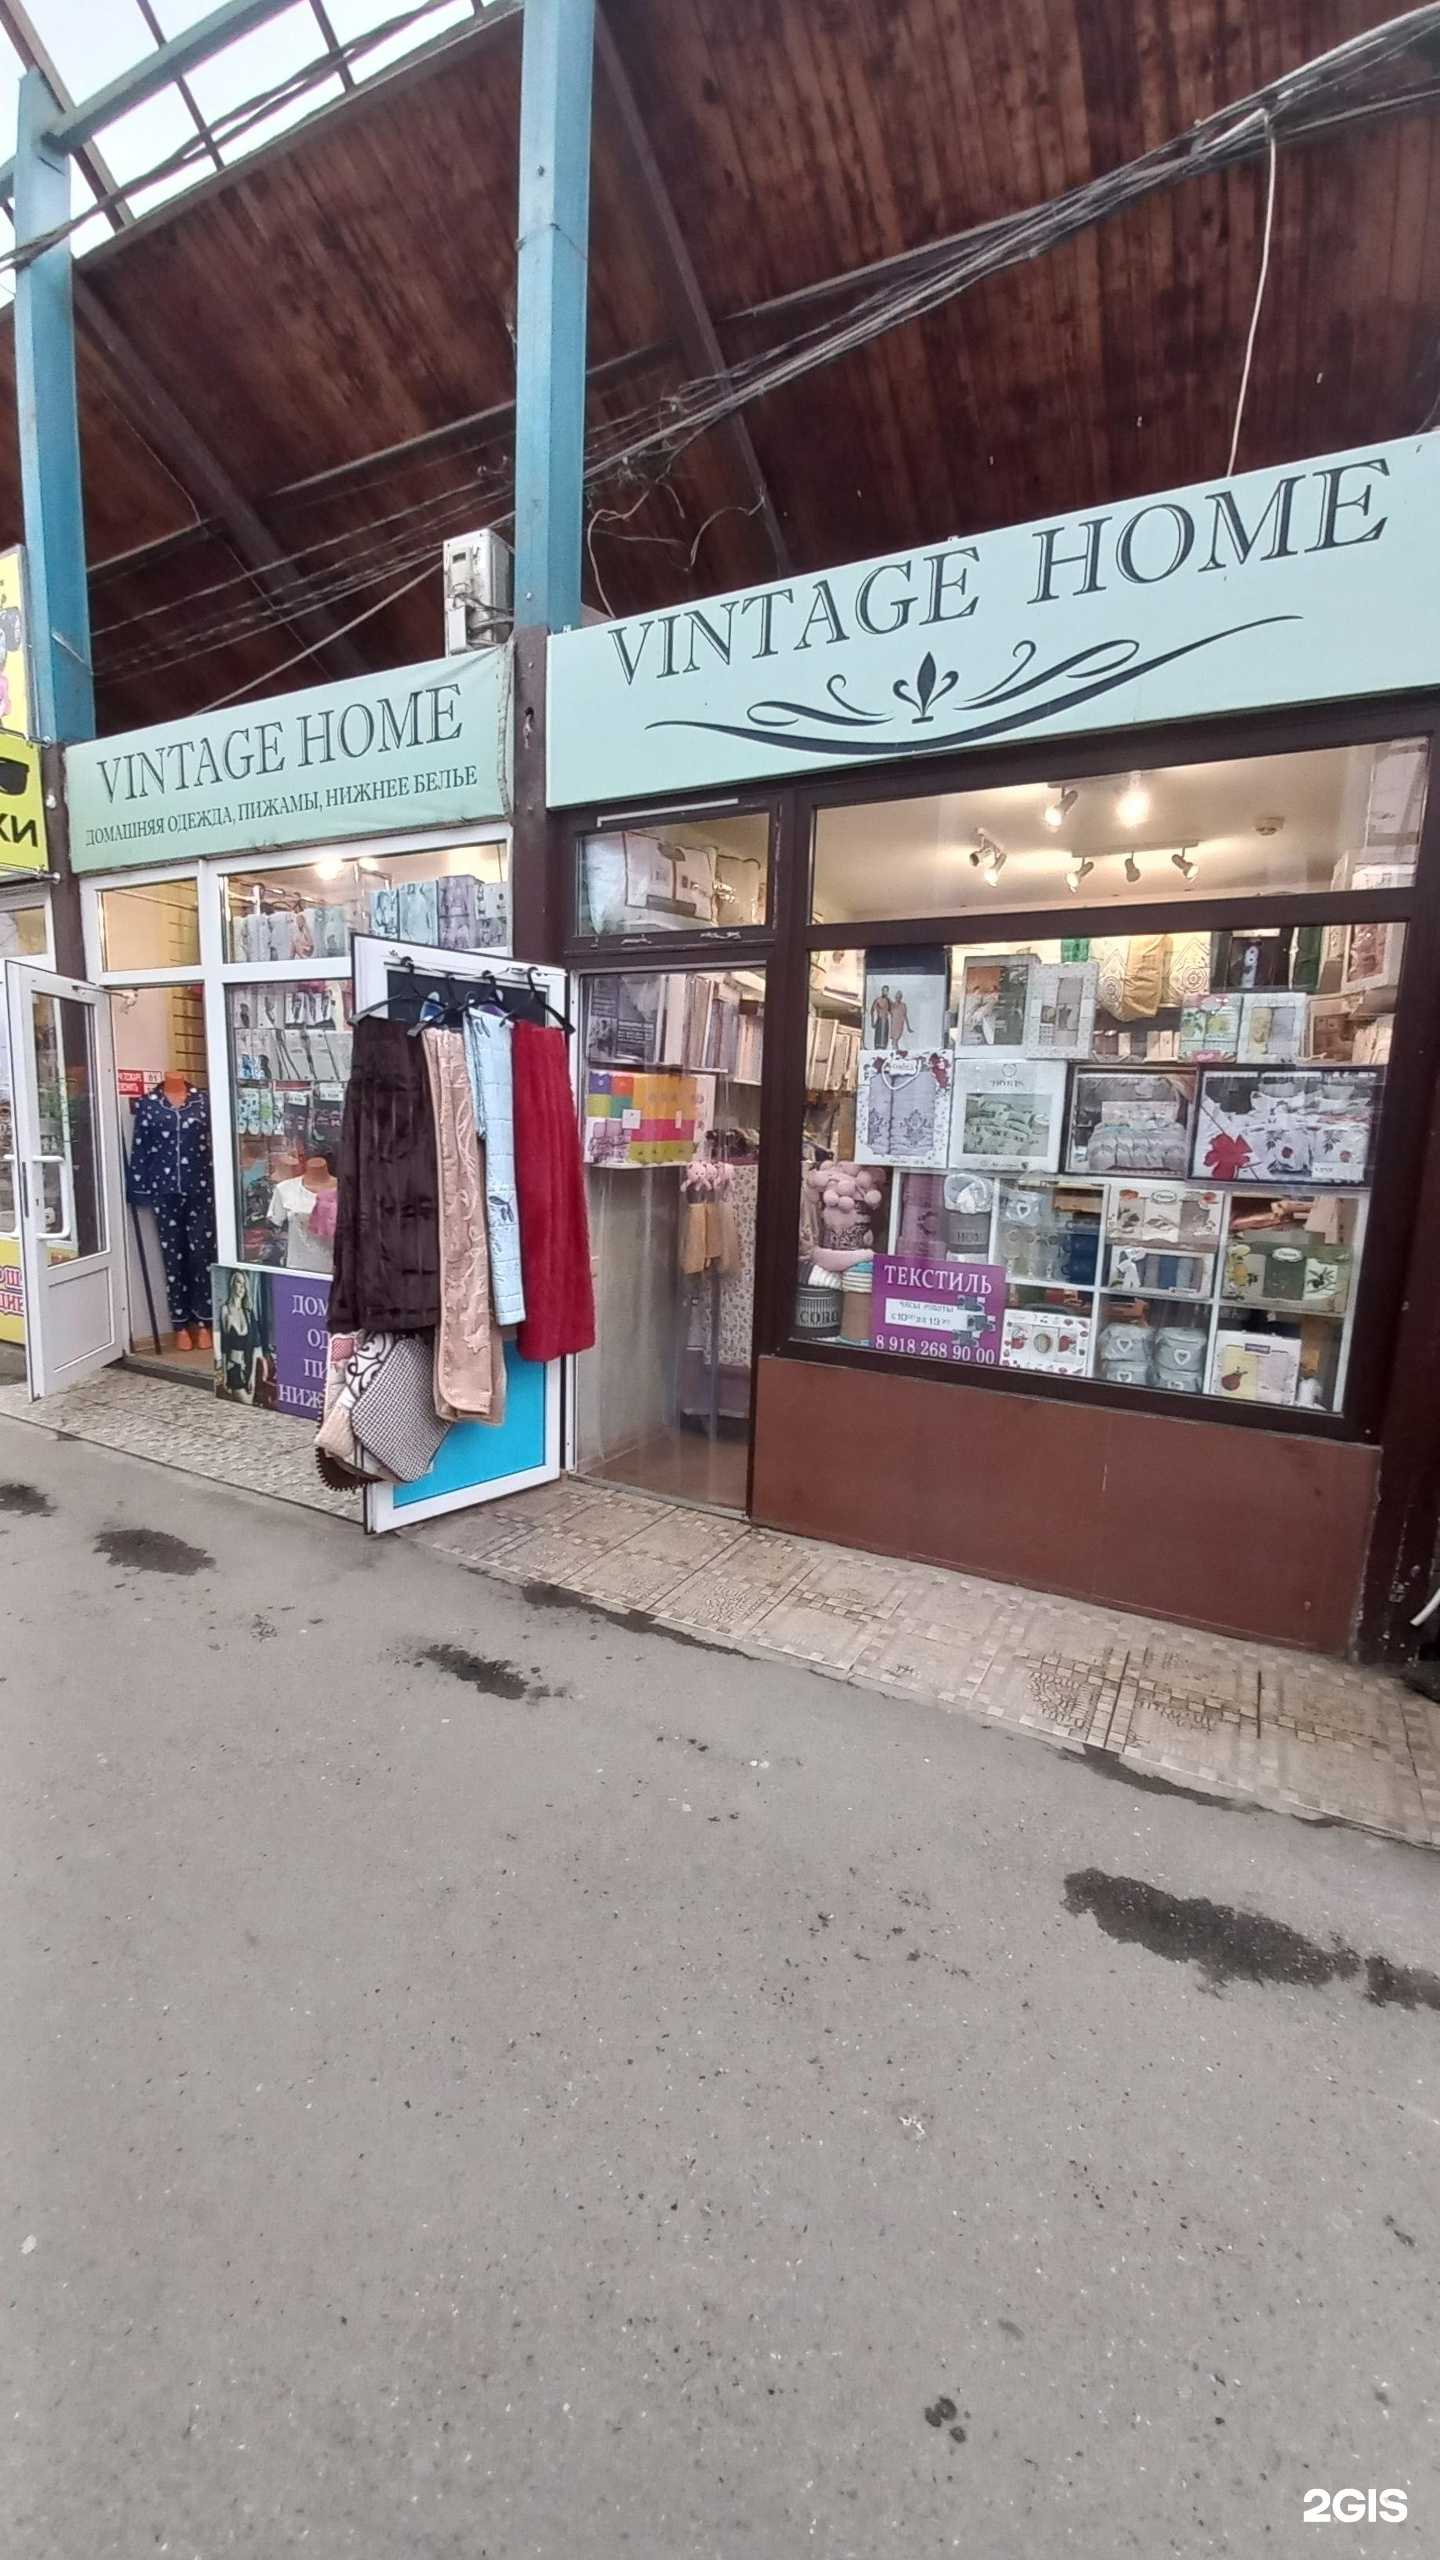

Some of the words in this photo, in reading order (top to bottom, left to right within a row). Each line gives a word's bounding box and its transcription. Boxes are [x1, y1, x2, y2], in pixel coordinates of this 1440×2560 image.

[608, 544, 981, 687] VINTAGE
[1026, 456, 1392, 607] HOME
[96, 720, 287, 804] VINTAGE
[296, 683, 464, 767] HOME
[86, 817, 165, 846] ДОМАШНЯЯ
[167, 806, 237, 835] ОДЕЖДА,
[238, 791, 323, 821] ПИЖАМЫ,
[325, 776, 410, 807] НИЖНЕЕ
[414, 765, 478, 793] БЕЛЬЕ
[884, 1265, 992, 1294] ТЕКСТИЛЬ
[875, 1334, 884, 1350] 8
[889, 1336, 916, 1354] 918
[920, 1340, 947, 1358] 268
[953, 1345, 970, 1361] 90
[976, 1348, 995, 1364] 00
